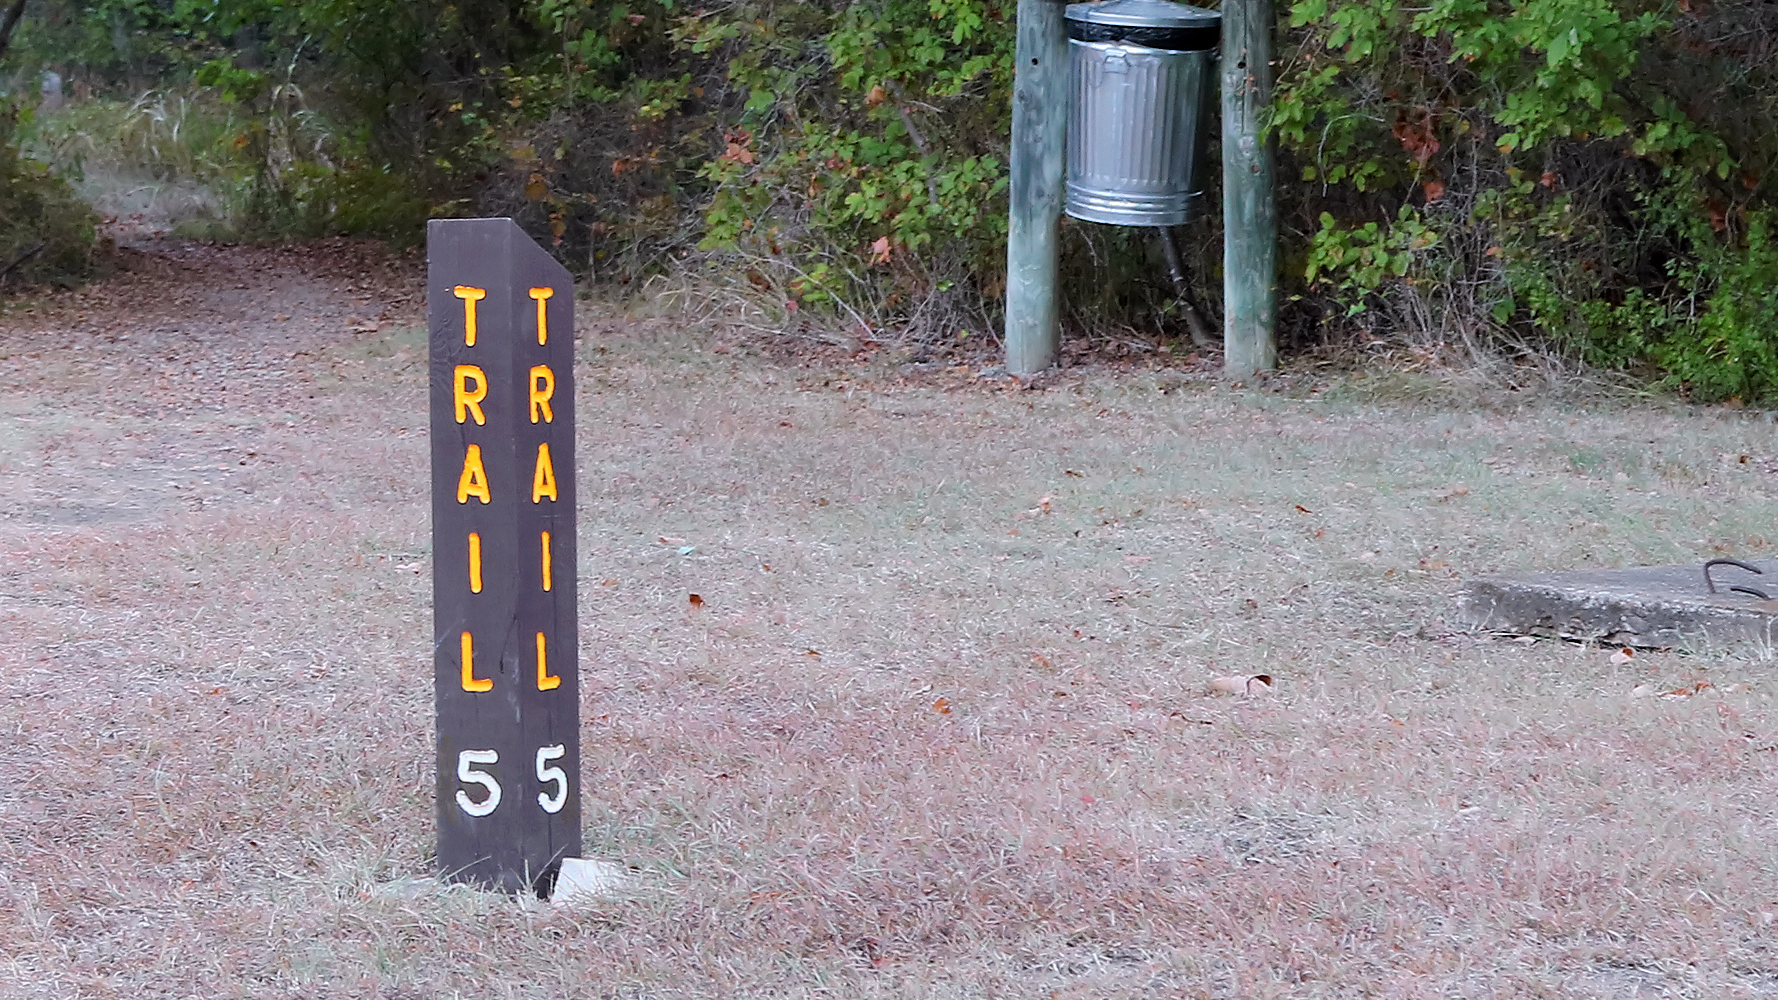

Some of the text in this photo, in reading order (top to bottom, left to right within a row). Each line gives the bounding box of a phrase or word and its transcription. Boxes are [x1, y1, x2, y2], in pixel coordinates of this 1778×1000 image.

[452, 285, 502, 817] TRAIL 5
[528, 286, 569, 814] TRAIL 5
